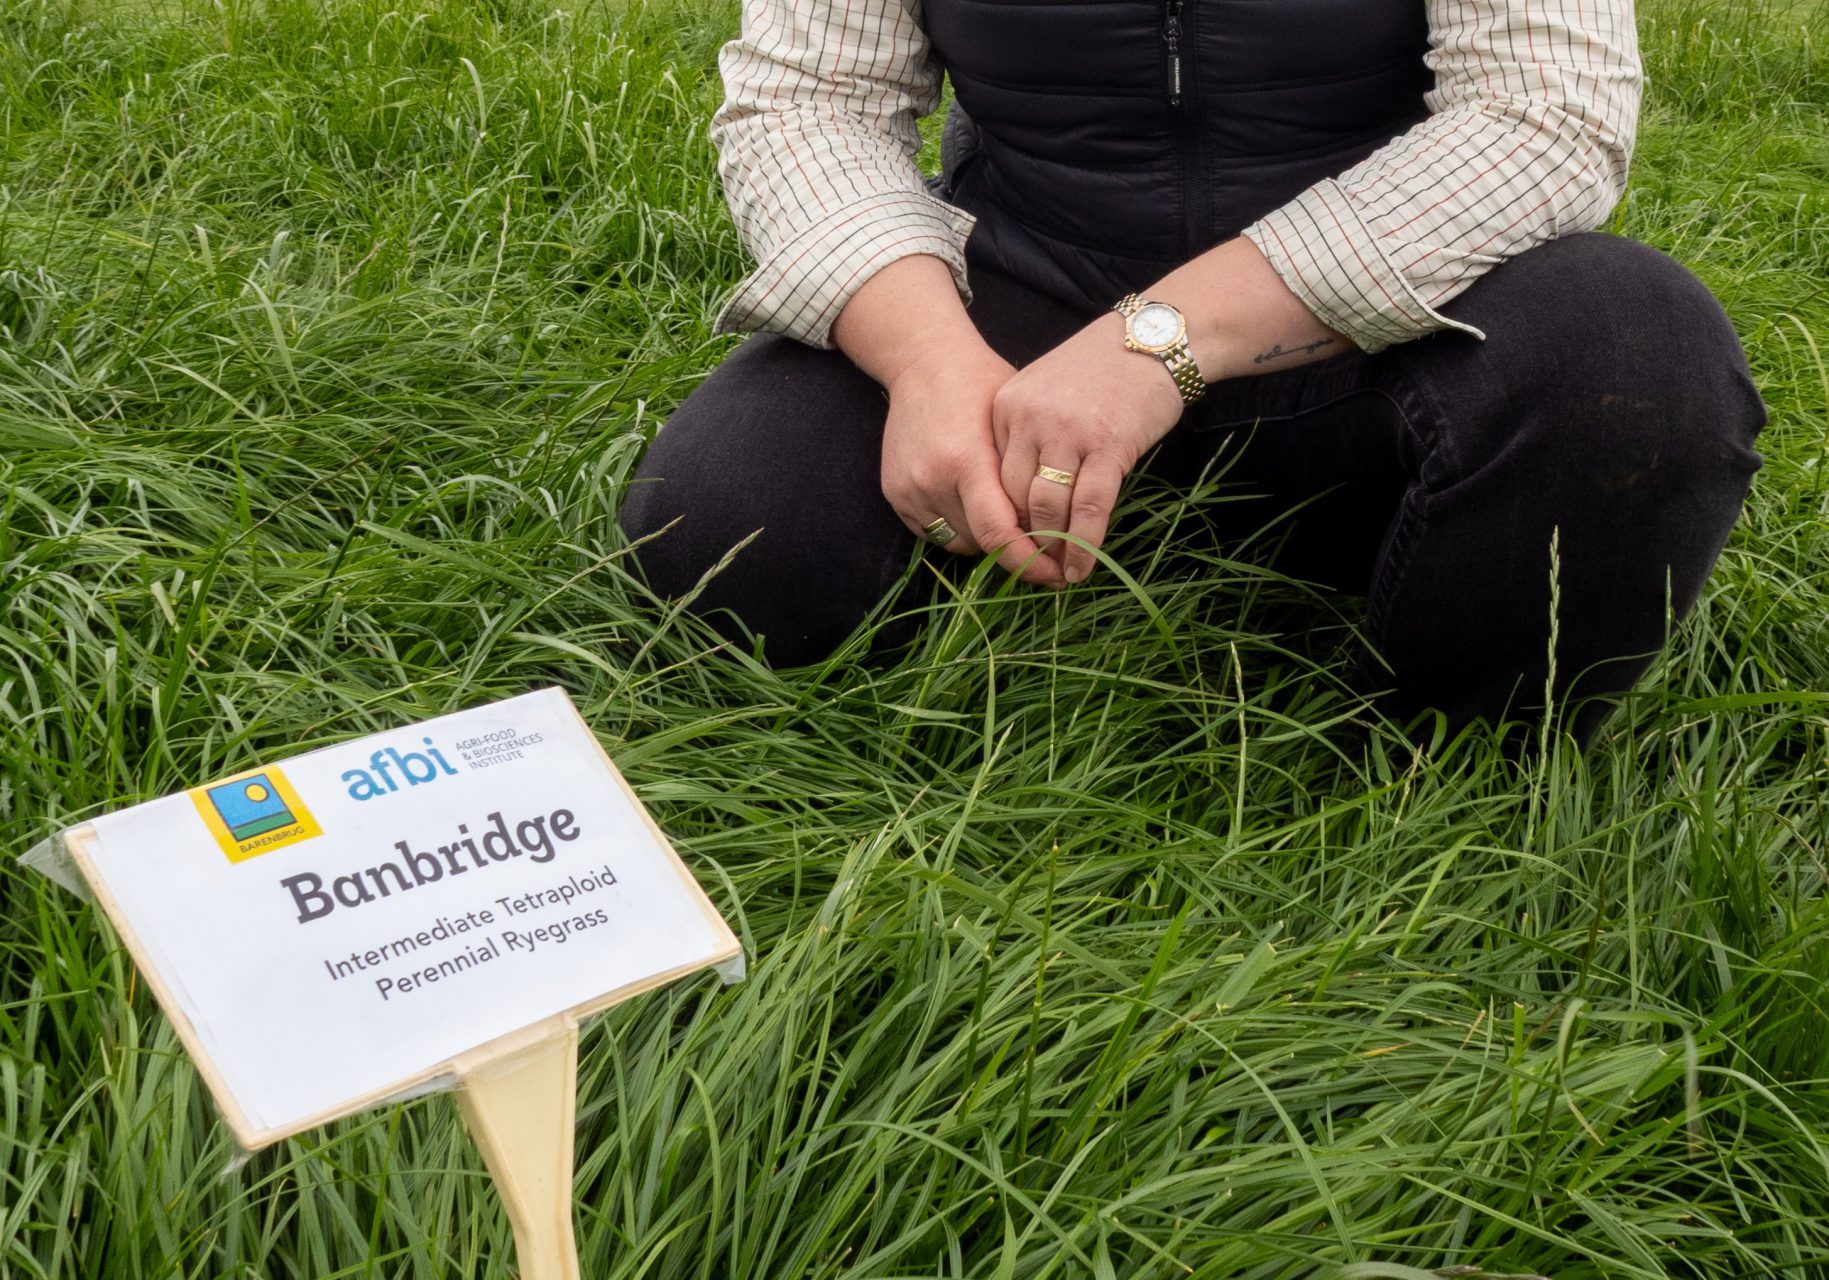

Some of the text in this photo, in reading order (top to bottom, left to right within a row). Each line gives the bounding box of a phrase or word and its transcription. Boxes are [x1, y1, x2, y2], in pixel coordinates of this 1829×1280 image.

[455, 728, 517, 752] AGRI-FOOD
[461, 732, 544, 761] & BIOSCIENCES
[468, 750, 525, 770] INSTITUTE
[340, 737, 459, 801] afbi
[239, 825, 305, 853] BARENBRUG
[280, 808, 581, 924] Banbridge
[324, 865, 618, 981] Intermediate Tetraploid
[375, 908, 609, 1001] Perennial Ryegrass
